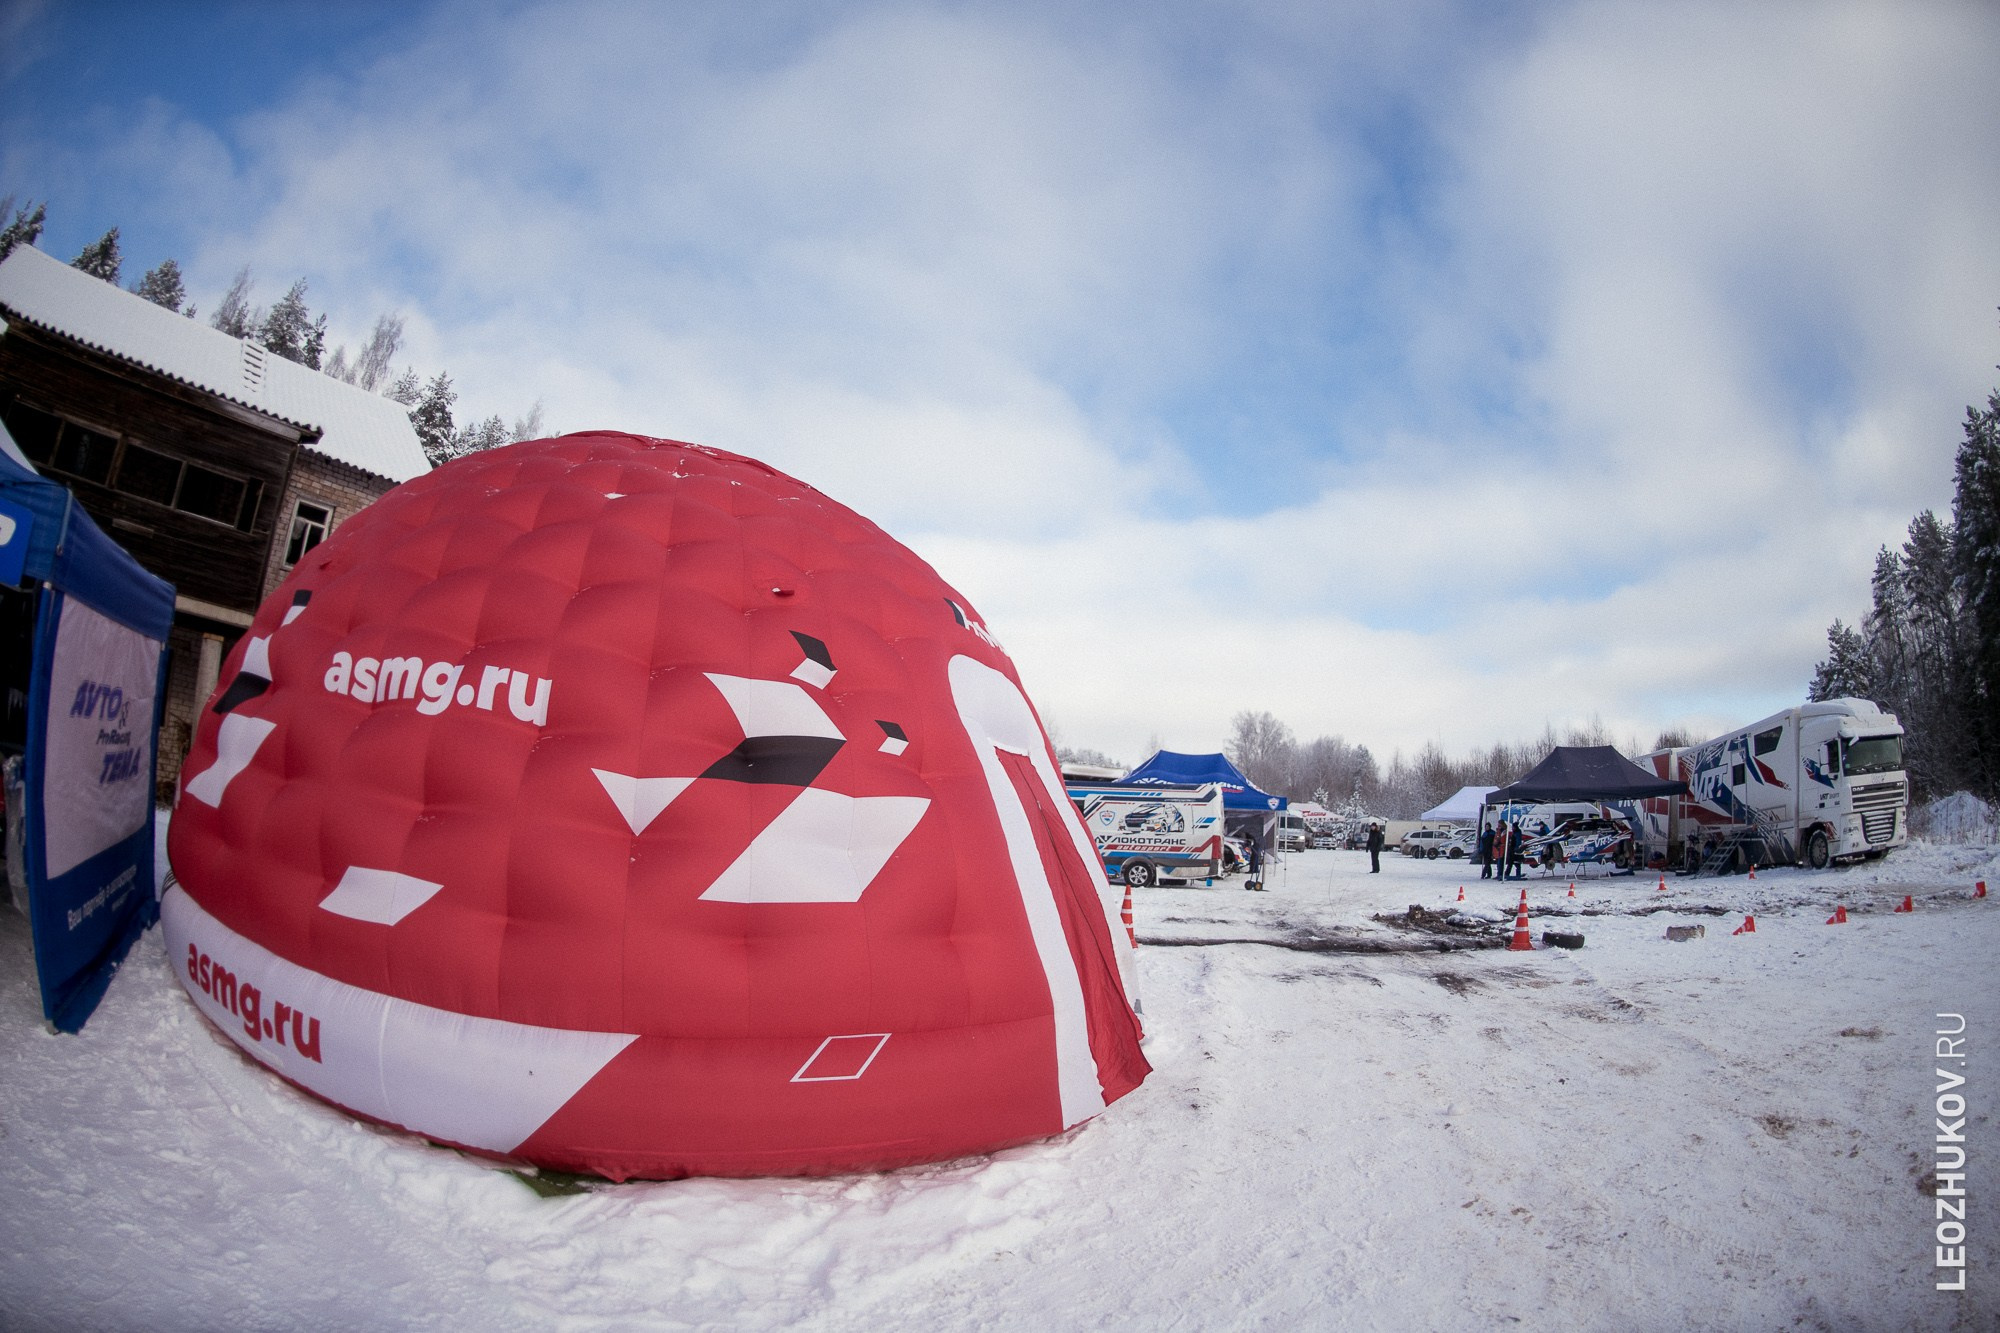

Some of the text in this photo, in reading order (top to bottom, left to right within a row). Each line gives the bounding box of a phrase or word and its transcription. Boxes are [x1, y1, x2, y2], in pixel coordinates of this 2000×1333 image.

[324, 651, 553, 727] asmg.ru
[1693, 763, 1728, 804] VRT
[1116, 844, 1173, 852] autosport
[187, 942, 322, 1064] asmg.ru
